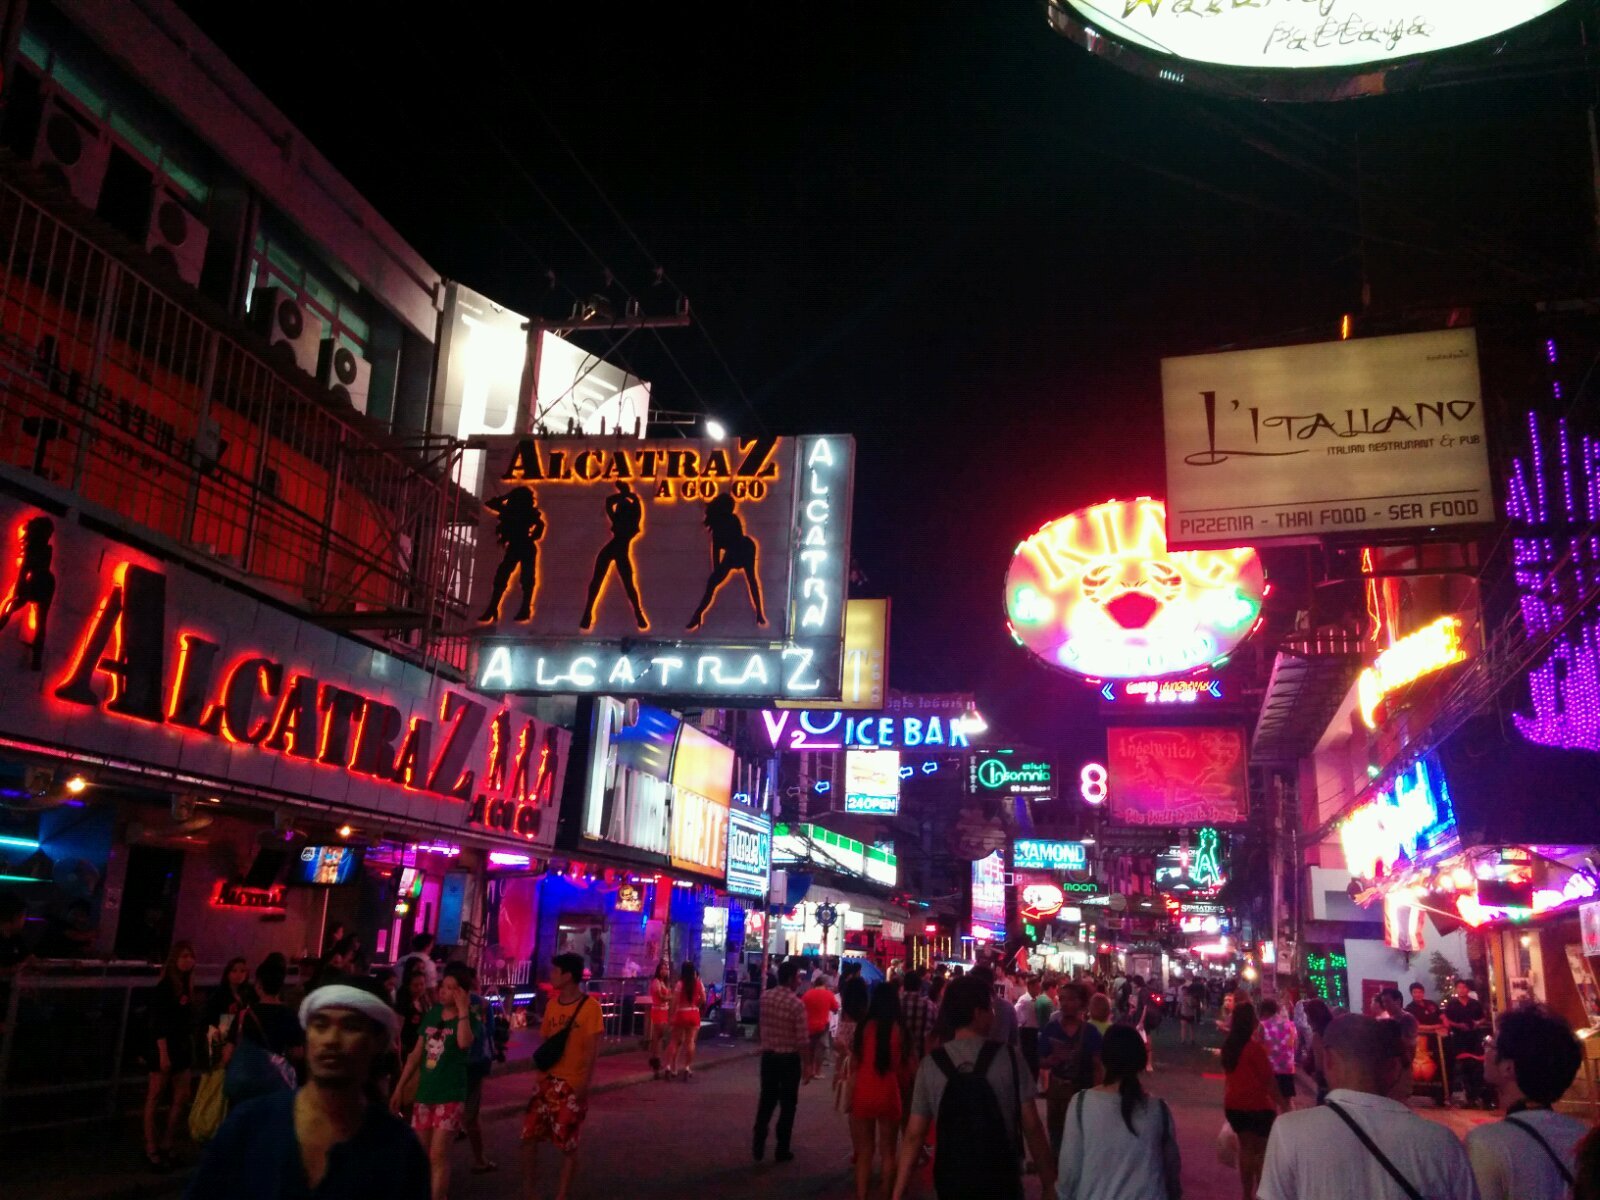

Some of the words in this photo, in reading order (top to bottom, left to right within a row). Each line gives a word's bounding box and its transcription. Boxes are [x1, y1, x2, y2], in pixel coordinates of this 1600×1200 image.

[503, 437, 779, 480] ALCATRAZ
[1327, 440, 1365, 456] ITALIAN
[1459, 433, 1480, 446] PUB
[655, 479, 674, 498] A
[1179, 514, 1255, 535] PIZZERIA
[1275, 511, 1312, 528] THAI
[1320, 507, 1367, 525] FOOD
[1388, 503, 1424, 520] SEA
[1430, 499, 1480, 517] FOOD
[54, 560, 487, 802] ALCATRAZ
[481, 646, 820, 689] ALCATRAZ
[845, 716, 894, 746] ICE
